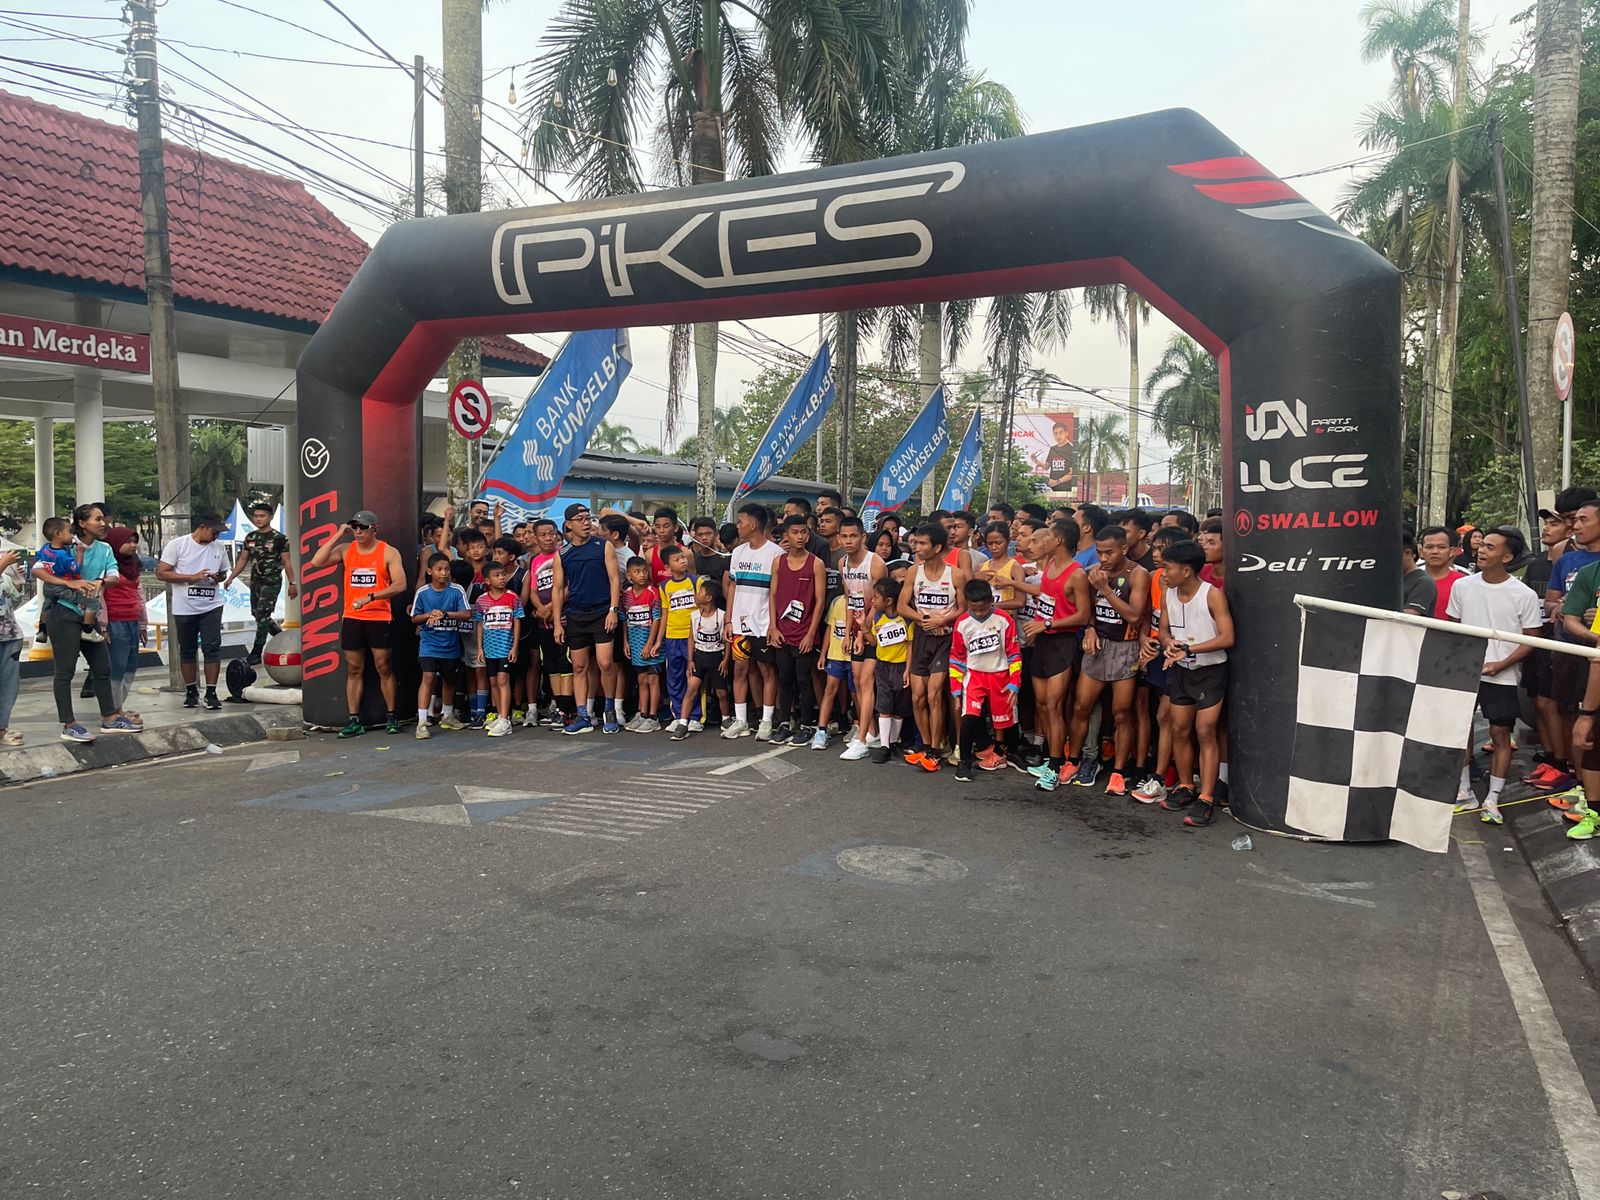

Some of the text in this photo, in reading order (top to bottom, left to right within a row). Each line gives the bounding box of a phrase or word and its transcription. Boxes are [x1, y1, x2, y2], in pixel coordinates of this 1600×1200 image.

[32, 326, 138, 362] Merdeka
[536, 373, 578, 440] BANK
[1310, 417, 1352, 426] PARTS
[1326, 425, 1359, 433] FORK
[889, 443, 918, 478] BANK
[1239, 453, 1369, 493] LUCE
[1257, 509, 1380, 531] SWALLOW
[1318, 556, 1377, 572] Tire
[351, 575, 376, 584] M-367
[670, 596, 695, 607] M-308
[918, 594, 948, 604] M-063
[878, 626, 906, 642] F-064
[969, 637, 999, 652] M-332
